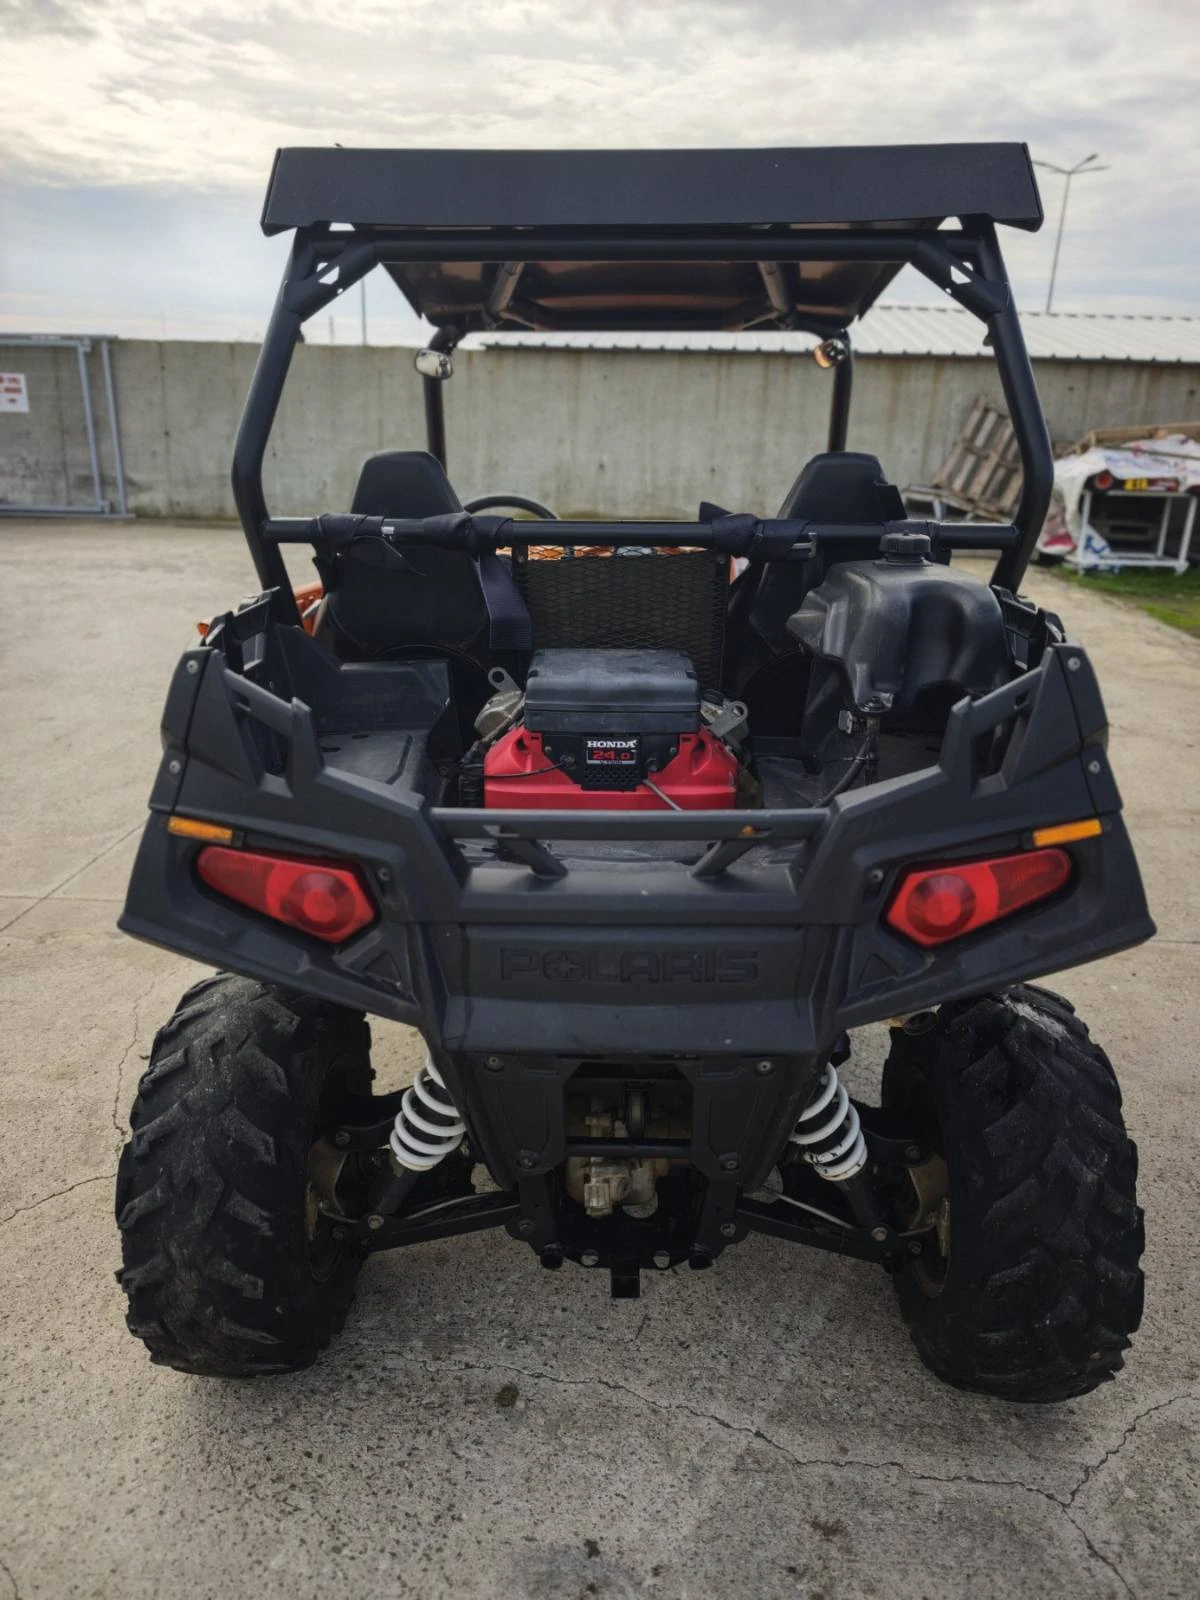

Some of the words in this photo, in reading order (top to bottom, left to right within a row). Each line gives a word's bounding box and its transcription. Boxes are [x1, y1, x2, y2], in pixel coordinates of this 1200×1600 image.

[587, 740, 637, 748] HONDA
[592, 750, 631, 760] 24.0
[500, 947, 760, 984] POLARIS
